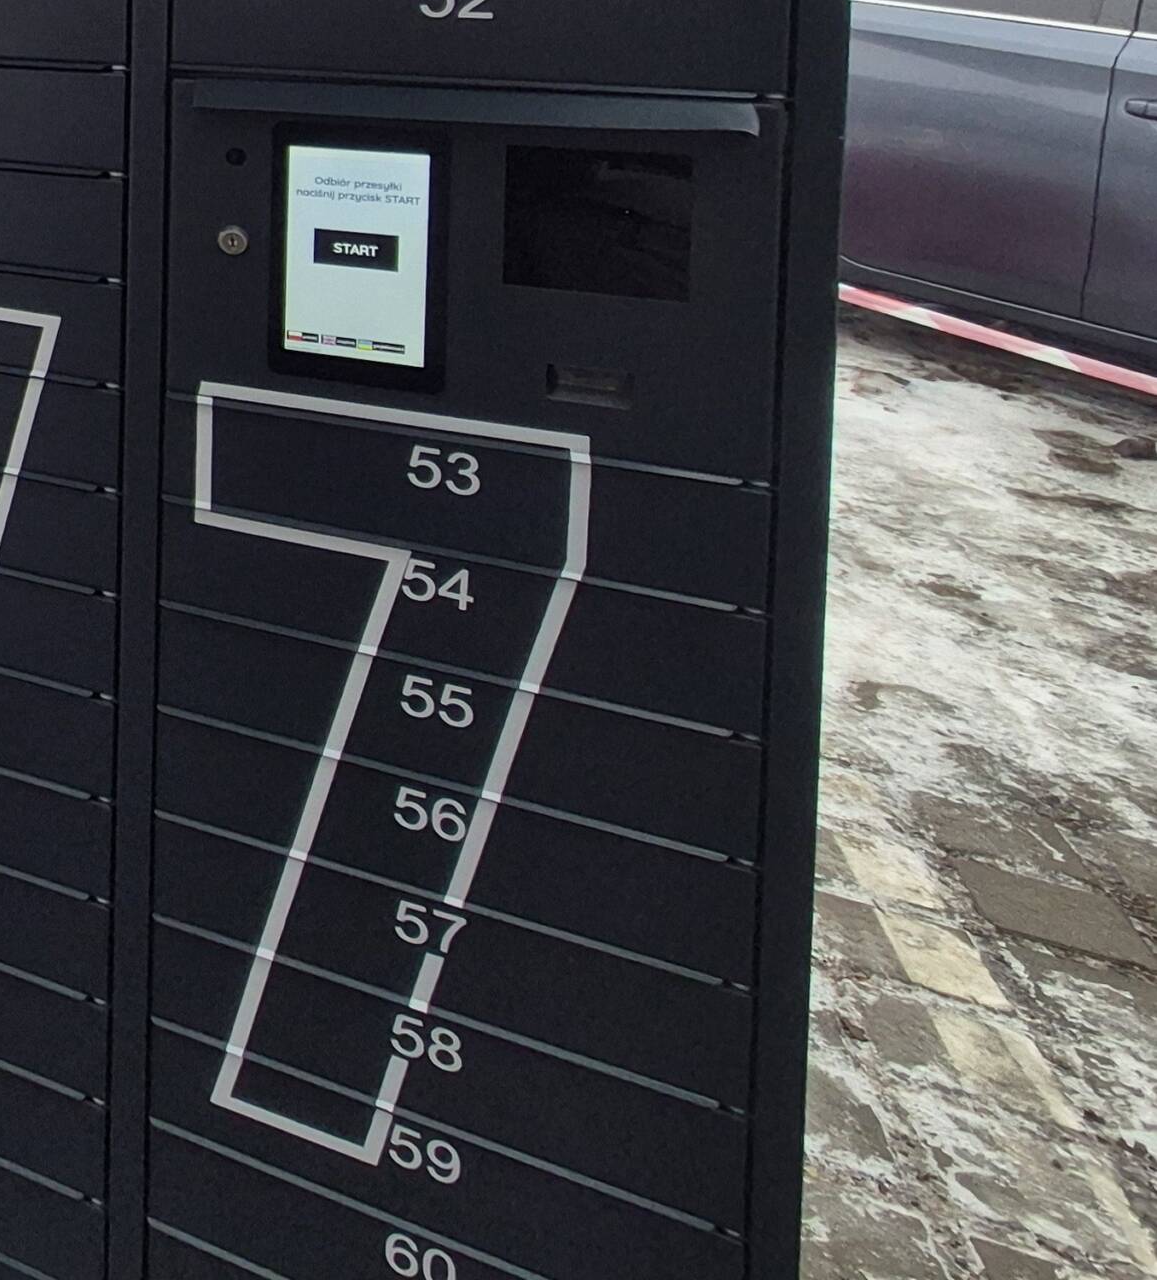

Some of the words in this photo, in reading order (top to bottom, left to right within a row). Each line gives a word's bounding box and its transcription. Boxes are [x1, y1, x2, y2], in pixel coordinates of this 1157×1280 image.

[296, 188, 335, 200] naciśnij
[338, 193, 383, 203] przycisk
[385, 195, 421, 206] START
[314, 176, 351, 187] Odbiór
[354, 180, 403, 192] przesyłki
[333, 242, 379, 257] START
[407, 445, 480, 496] 53
[401, 558, 474, 611] 54
[400, 674, 474, 728] 55
[393, 786, 466, 842] 56
[394, 900, 467, 953] 57
[390, 1014, 462, 1072] 58
[389, 1124, 461, 1184] 59
[385, 1233, 457, 1280] 60
